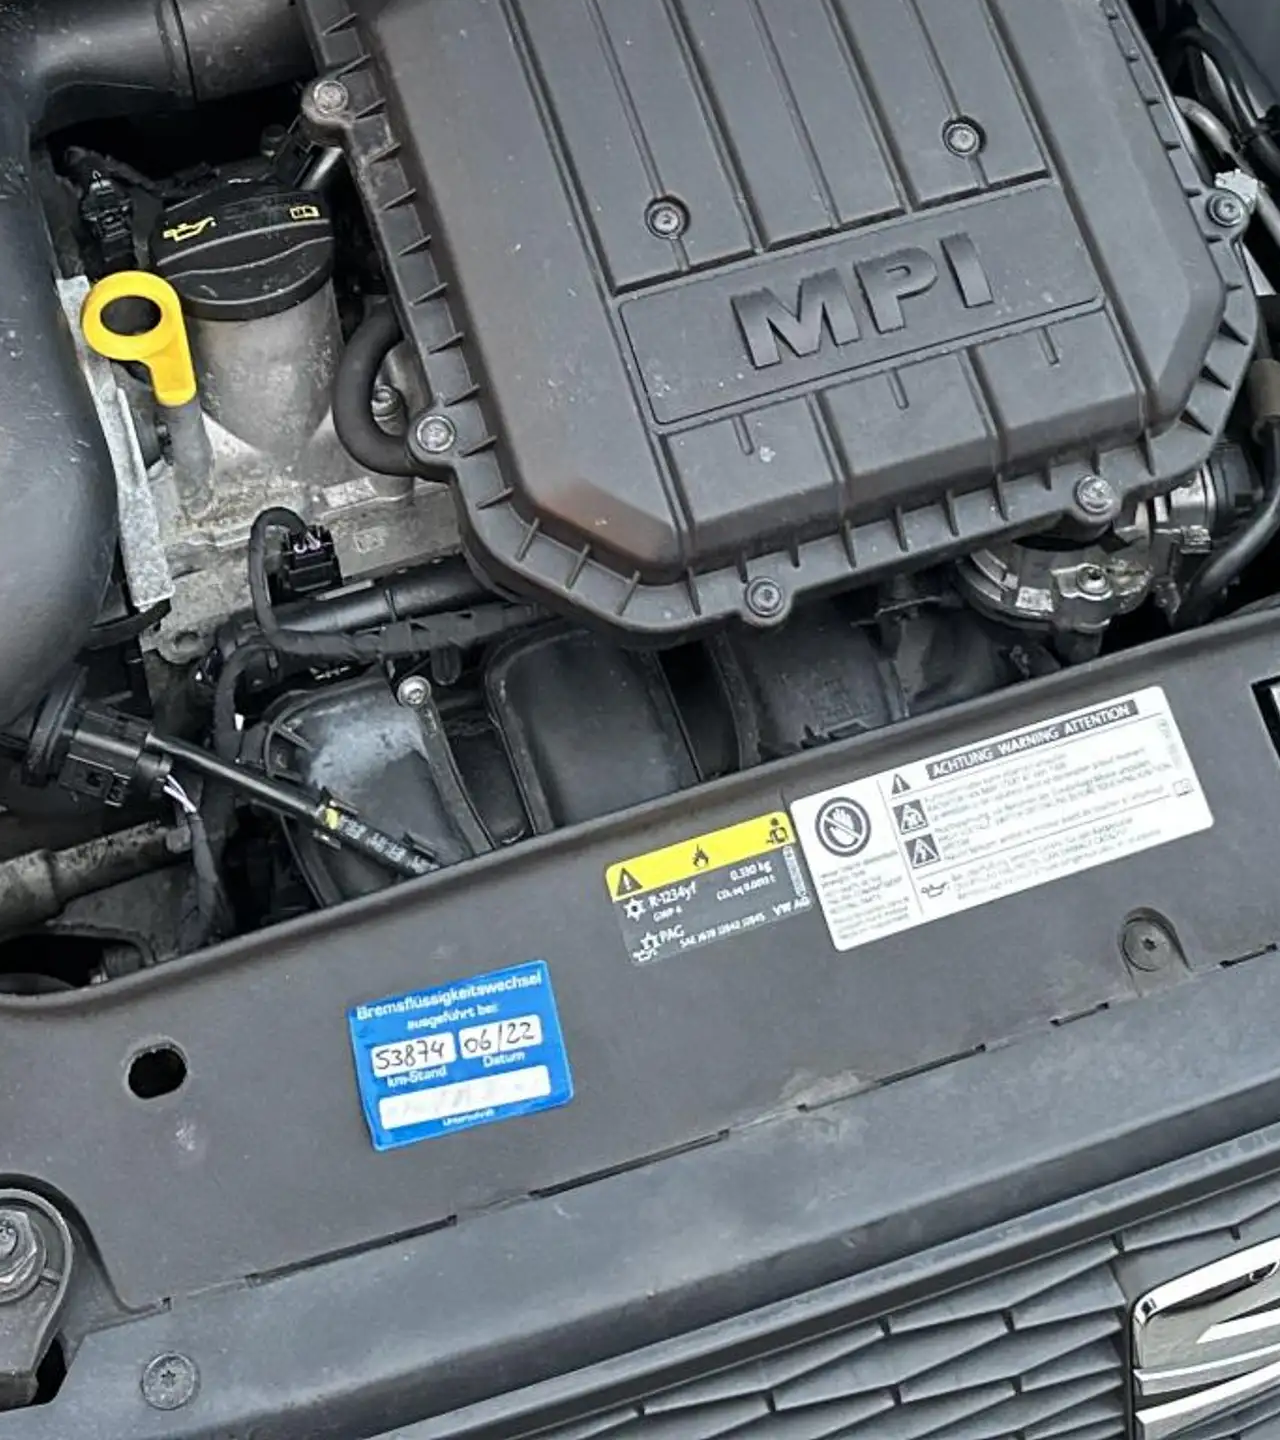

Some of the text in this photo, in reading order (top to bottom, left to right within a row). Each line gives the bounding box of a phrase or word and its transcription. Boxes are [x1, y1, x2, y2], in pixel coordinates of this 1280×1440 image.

[730, 232, 994, 370] MPI
[932, 703, 1130, 779] ACHTUNG WARNING ATTENTION
[659, 924, 685, 944] PAG
[356, 970, 542, 1021] Bremsflüssigkeitswechsel
[464, 1021, 534, 1052] 06/22
[387, 1051, 525, 1088] km-Stand Datum
